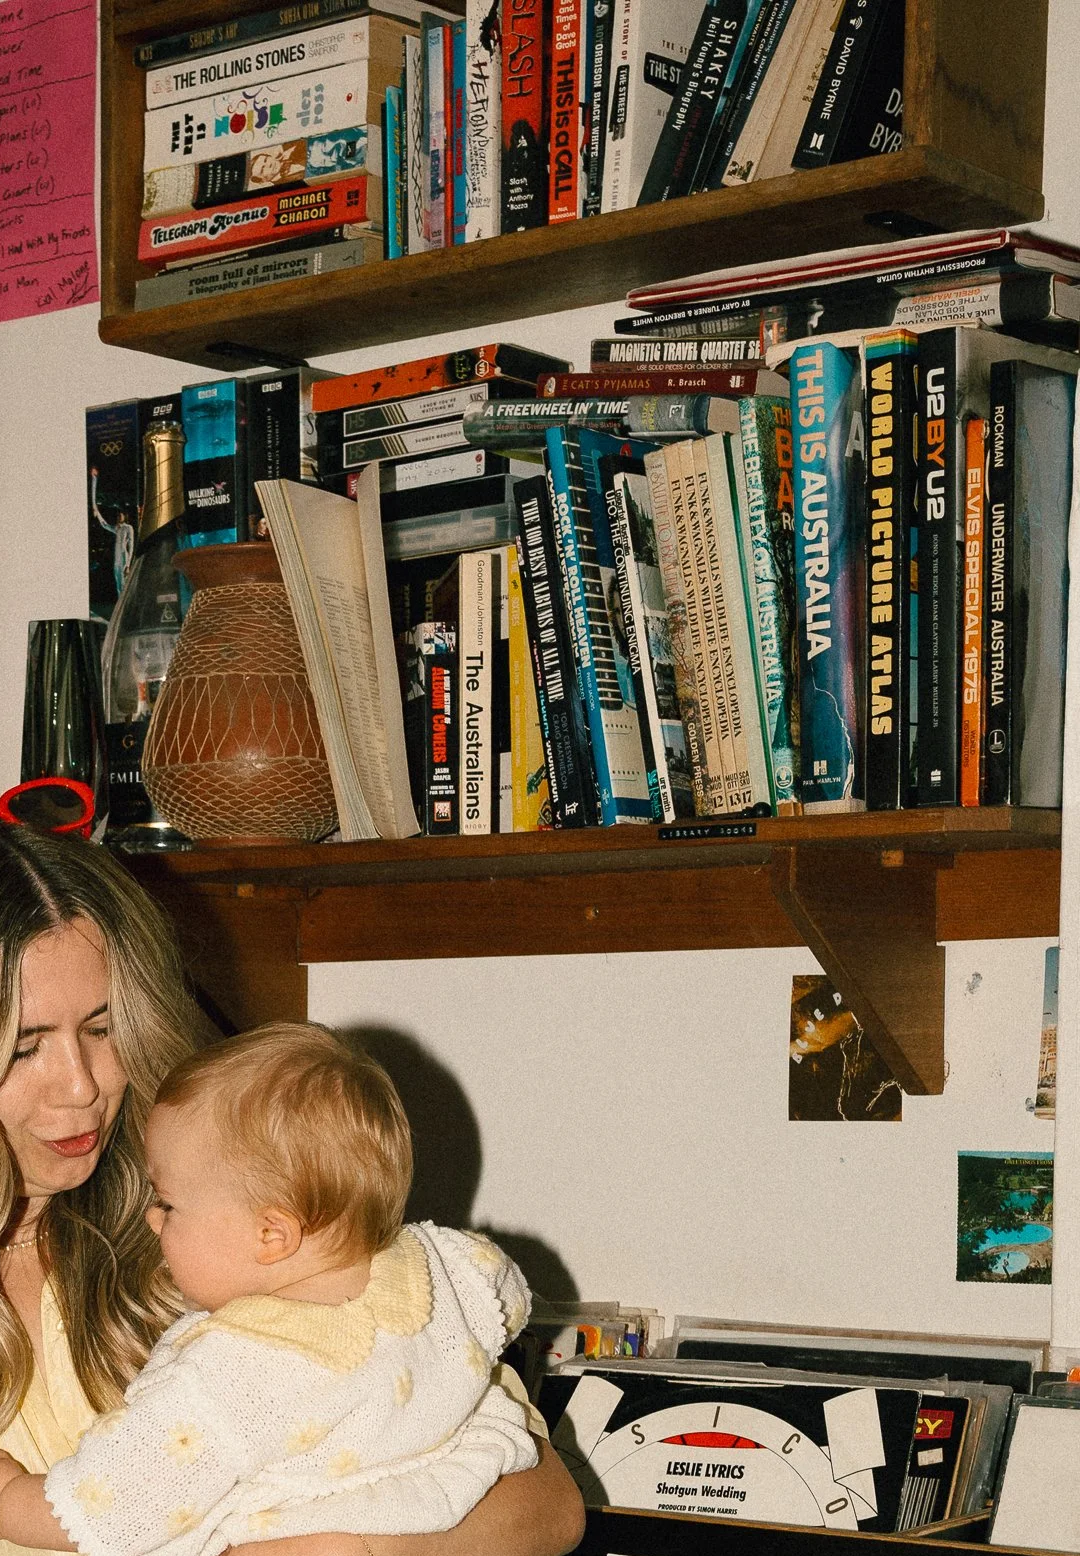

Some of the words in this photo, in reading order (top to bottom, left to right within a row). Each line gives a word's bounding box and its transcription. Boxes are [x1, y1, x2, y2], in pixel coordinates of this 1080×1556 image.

[556, 13, 577, 24] Times
[559, 4, 575, 14] and
[556, 31, 576, 43] Dave
[622, 19, 630, 46] STORY
[706, 16, 721, 38] Neil
[173, 71, 196, 91] THE
[200, 57, 251, 85] ROLLING
[256, 43, 306, 71] STONES
[594, 43, 604, 89] ORBISON
[693, 40, 713, 78] Young's
[700, 20, 737, 100] SHAKEY
[753, 38, 766, 65] COHEN
[836, 37, 855, 76] DAVID
[18, 65, 42, 81] Time
[556, 52, 575, 109] THIS
[617, 87, 628, 124] STREETS
[671, 80, 699, 131] Biography
[820, 79, 841, 120] BYRNE
[0, 129, 27, 145] Plans
[3, 183, 33, 200] Giant
[554, 149, 572, 200] CALL
[279, 191, 327, 211] MICHAEL
[279, 205, 327, 224] CHABON
[152, 220, 207, 245] TELEGRAPH
[208, 207, 269, 236] Avenue
[188, 273, 219, 287] room
[222, 266, 244, 282] full
[246, 264, 260, 277] of
[261, 255, 309, 274] mirrors
[195, 278, 239, 297] biography
[272, 265, 308, 281] hendrix
[876, 272, 903, 284] GUITAR
[904, 266, 935, 279] RHYTHM
[936, 257, 986, 273] PROGRESSIVE
[17, 277, 39, 289] Man
[632, 316, 653, 328] WHITE
[694, 304, 720, 316] TURNER
[721, 301, 740, 311] GARY
[897, 300, 956, 314] CROSSROADS
[915, 308, 946, 318] DYLAN
[947, 305, 965, 314] BOB
[610, 343, 660, 362] MAGNETIC
[663, 342, 698, 361] TRAVEL
[701, 341, 747, 362] QUARTET
[571, 379, 600, 390] CAT'S
[603, 379, 651, 391] PYJAMAS
[678, 378, 706, 387] Brasch
[795, 350, 824, 429] THIS
[927, 367, 945, 418] U2
[596, 401, 631, 414] TIME
[871, 361, 894, 477] WORLD
[800, 431, 827, 464] IS
[927, 419, 945, 467] BY
[994, 405, 1004, 468] ROCKMAN
[188, 487, 214, 499] WALKING
[197, 493, 230, 508] DINOSAURS
[671, 479, 684, 513] FUNK
[685, 475, 698, 509] FUNK
[744, 455, 767, 543] BEAUTY
[927, 469, 945, 521] U2
[967, 468, 981, 537] ELVIS
[522, 498, 540, 526] THE
[557, 492, 572, 537] ROCK
[526, 526, 544, 547] 100
[691, 521, 707, 585] WAGNALLS
[529, 548, 547, 578] BEST
[678, 525, 694, 588] WAGNALLS
[801, 470, 832, 661] AUSTRALIA
[871, 487, 893, 624] PICTURE
[991, 503, 1005, 613] UNDERWATER
[568, 565, 584, 603] ROLL
[964, 540, 982, 645] SPECIAL
[477, 560, 485, 646] Goodman/Johnston
[533, 581, 554, 629] ALBUMS
[614, 548, 634, 624] CONTINUING
[625, 625, 641, 676] ENIGMA
[687, 589, 702, 650] WILDLIFE
[697, 471, 710, 507] FUNK
[704, 518, 720, 582] WAGNALLS
[713, 582, 730, 645] WILDLIFE
[722, 645, 742, 738] ENCYCLOPEDIA
[700, 585, 715, 648] WILDLIFE
[540, 628, 556, 644] OF
[574, 604, 591, 668] HEAVEN
[466, 651, 483, 693] The
[543, 646, 559, 670] ALL
[963, 646, 979, 705] 1975
[991, 619, 1005, 706] AUSTRALIA
[431, 666, 445, 709] ALBUM
[546, 670, 564, 703] TIME
[694, 651, 713, 743] ENCYCLOPEDIA
[709, 648, 730, 741] ENCYCLOPEDIA
[871, 636, 893, 736] ATLAS
[432, 711, 447, 763] COVERS
[466, 702, 483, 820] Australians
[688, 722, 700, 762] GOLDEN
[694, 763, 704, 798] PRESS
[741, 790, 752, 804] 17
[817, 776, 841, 784] HAMLYN
[729, 793, 742, 807] 13
[1004, 1158, 1036, 1166] GREETINGS
[1037, 1158, 1053, 1166] FROM
[666, 1461, 703, 1478] LESLIE
[704, 1462, 745, 1480] LYRICS
[656, 1482, 698, 1498] Shotgun
[701, 1485, 747, 1502] Wedding
[658, 1503, 686, 1513] PRODUCED
[696, 1505, 716, 1514] SIMON
[717, 1507, 738, 1515] HARRIS
